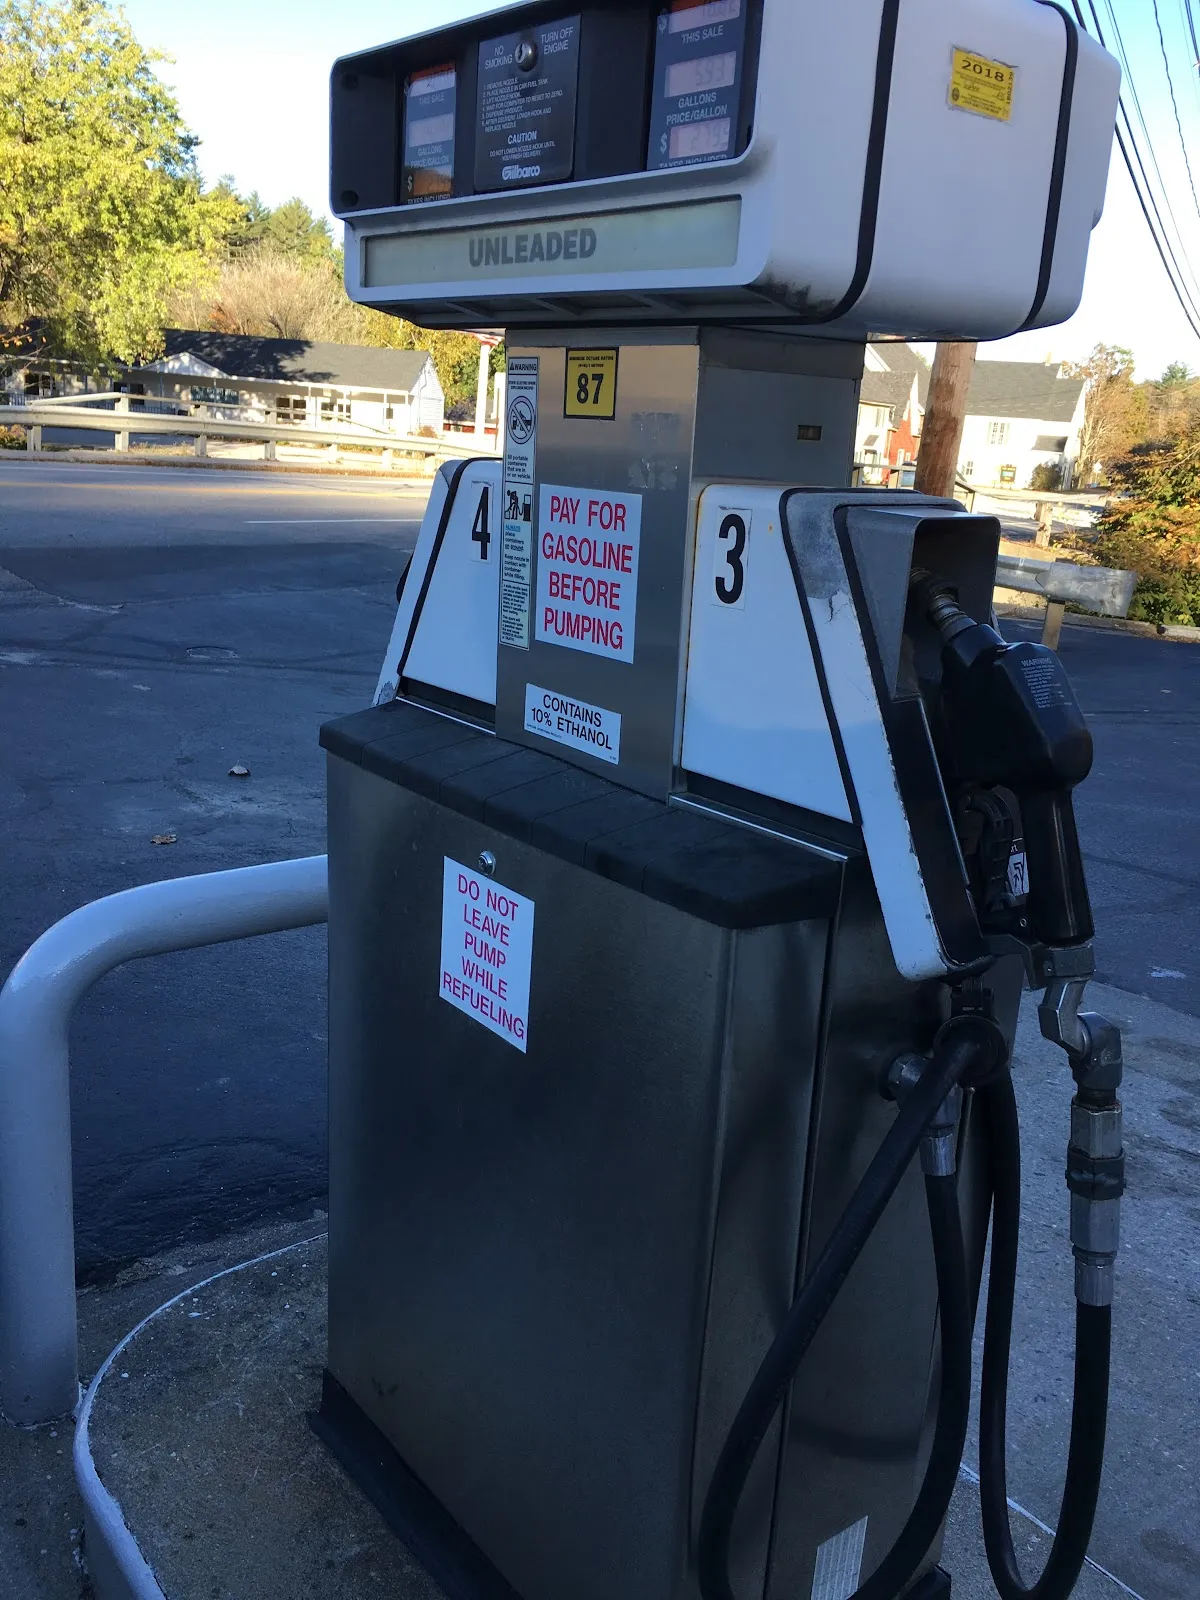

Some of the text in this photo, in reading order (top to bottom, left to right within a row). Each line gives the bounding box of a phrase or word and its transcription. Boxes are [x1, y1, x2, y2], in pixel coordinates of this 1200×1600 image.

[541, 27, 574, 44] TURN OFF
[544, 40, 568, 55] ENGINE
[681, 25, 724, 44] THIS SALE
[485, 54, 512, 70] SMOKING
[494, 46, 504, 56] NO
[962, 60, 1004, 82] 2018
[419, 93, 444, 105] THIS SALE
[678, 92, 717, 108] GALLONS
[666, 104, 728, 125] PRICE/GALLON
[418, 145, 442, 156] GALLONS
[508, 131, 537, 144] CAUTION
[660, 133, 667, 154] $
[407, 174, 412, 192] $
[502, 165, 540, 180] Gilbarco
[469, 228, 597, 267] UNLEADED
[577, 373, 604, 404] 87
[472, 487, 490, 560] 4
[550, 496, 626, 531] PAY FOR
[542, 532, 633, 573] GASOLINE
[715, 514, 746, 604] 3
[549, 571, 620, 610] BEFORE
[544, 607, 622, 649] PUMPING
[1021, 658, 1052, 666] WARNING
[543, 694, 602, 727] CONTAINS
[532, 707, 552, 726] 10%
[557, 717, 612, 750] ETHANOL
[457, 874, 519, 921] DO NOT
[464, 904, 510, 946] LEAVE
[464, 931, 506, 968] PUMP
[462, 956, 507, 1001] WHILE
[443, 971, 524, 1039] REFUELING
